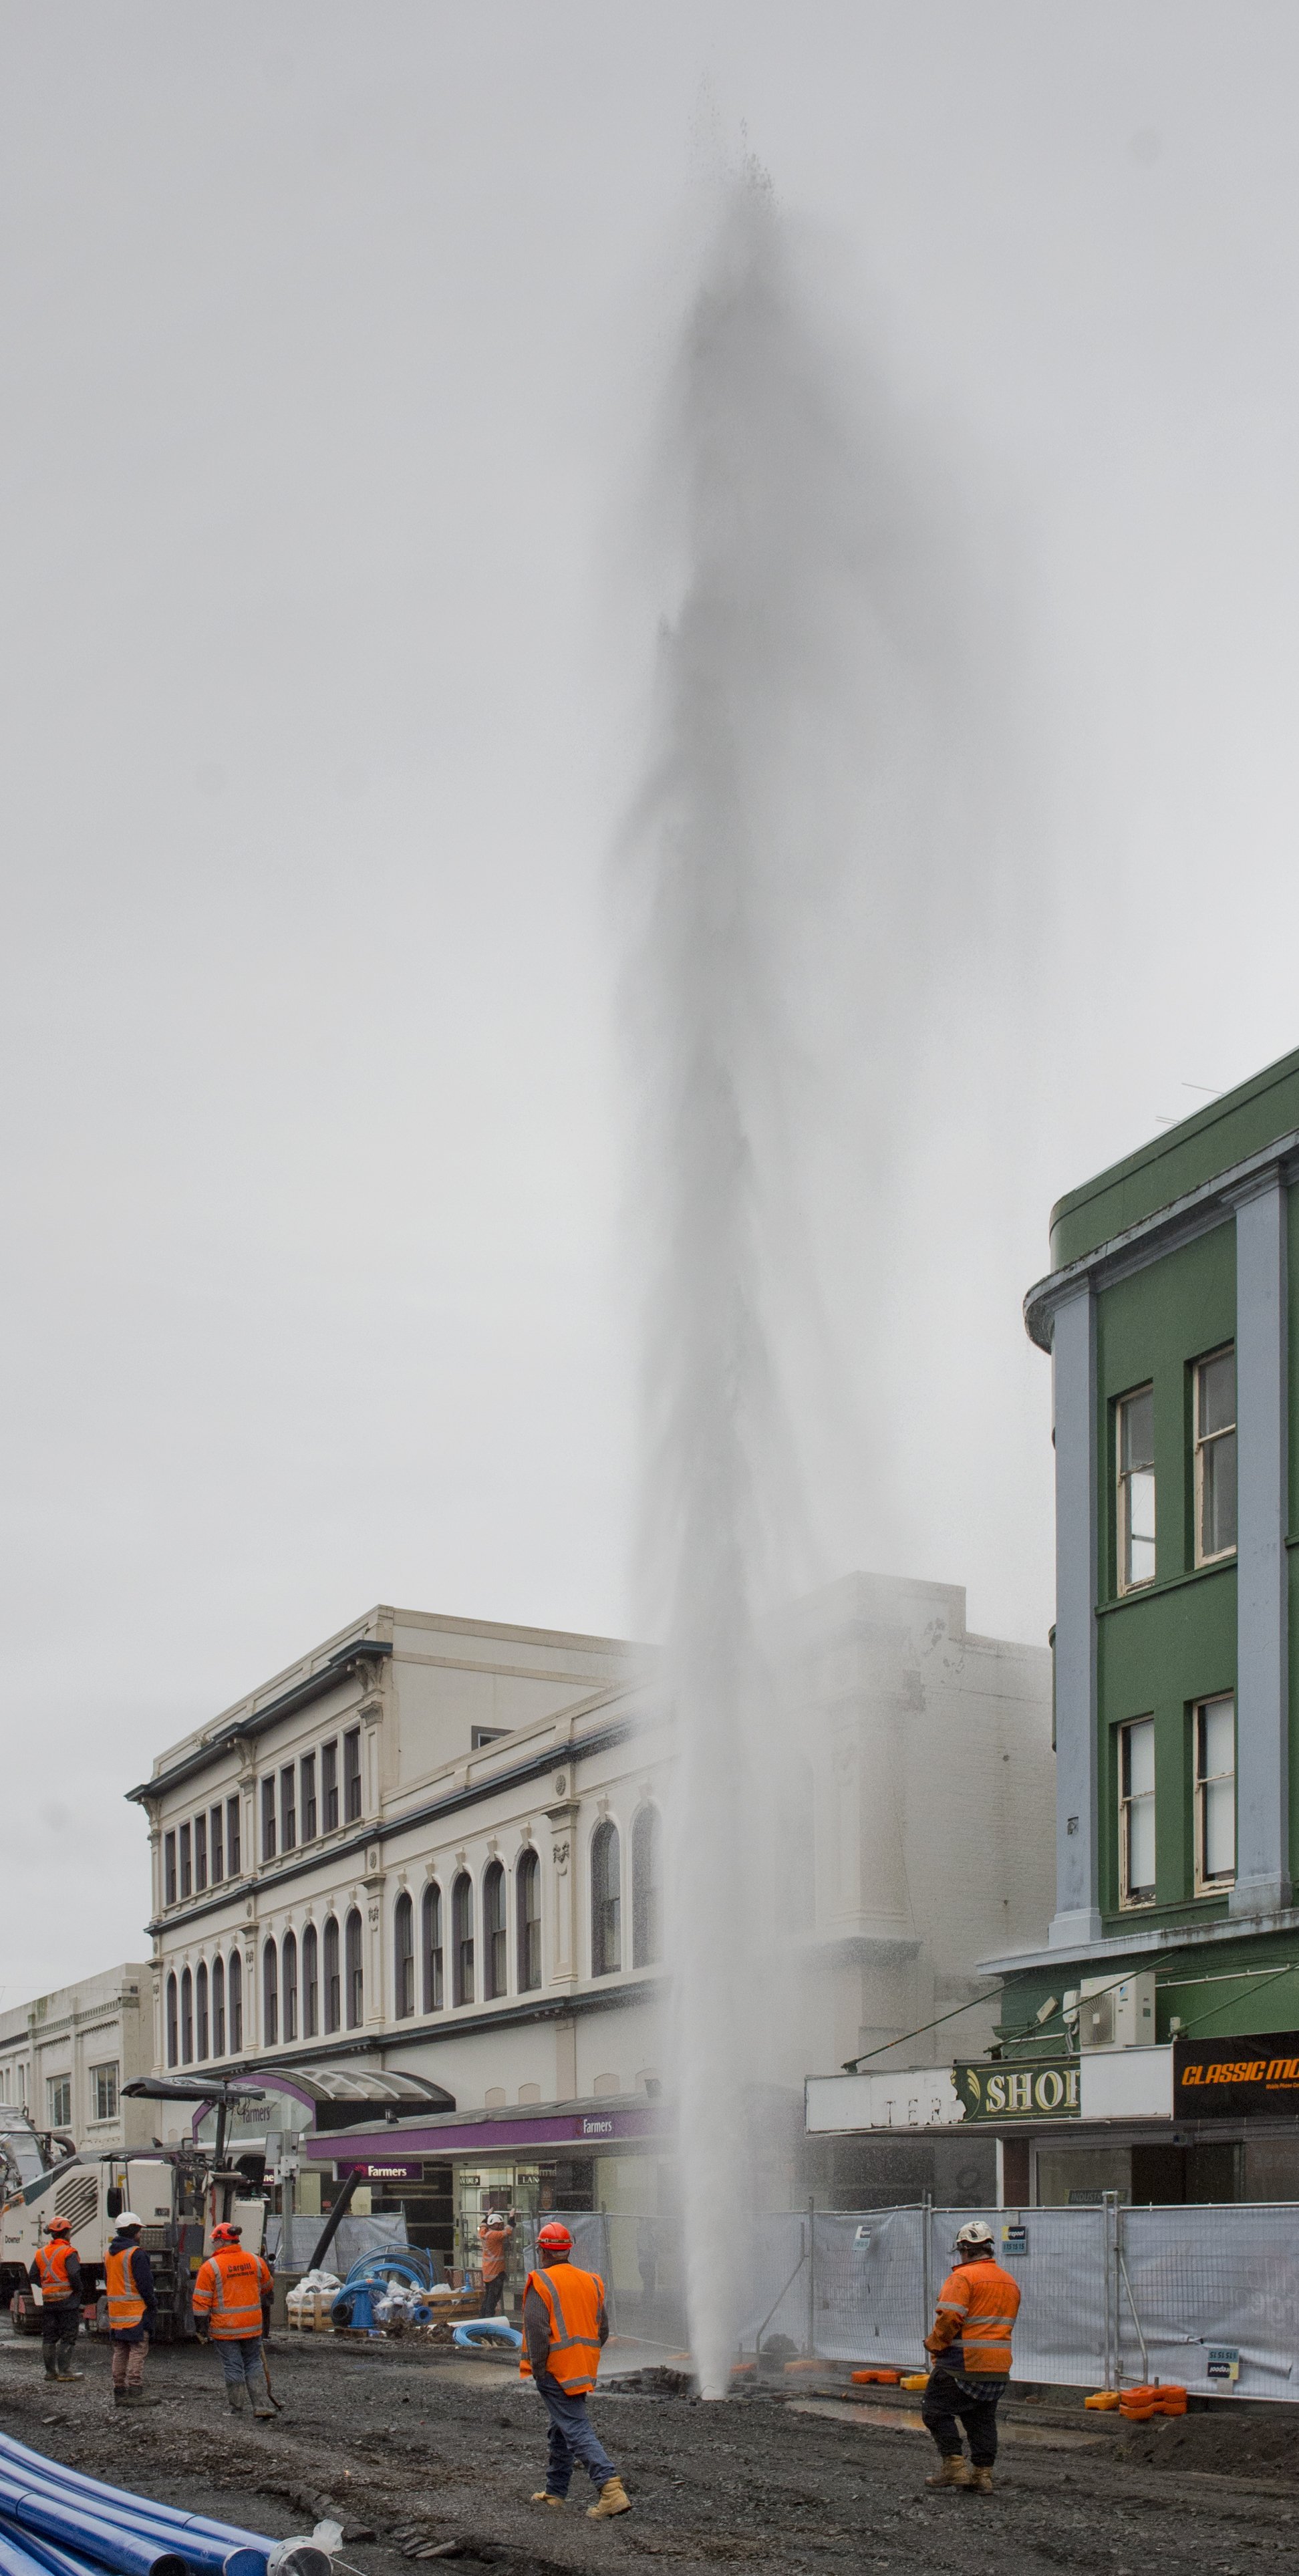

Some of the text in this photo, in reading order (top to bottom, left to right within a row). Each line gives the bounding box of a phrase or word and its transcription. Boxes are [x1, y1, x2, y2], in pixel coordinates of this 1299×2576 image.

[1181, 2061, 1267, 2086] CLASSIC
[583, 2119, 612, 2134] Farmers
[368, 2165, 407, 2177] Farmers
[228, 2261, 251, 2273] Cargill
